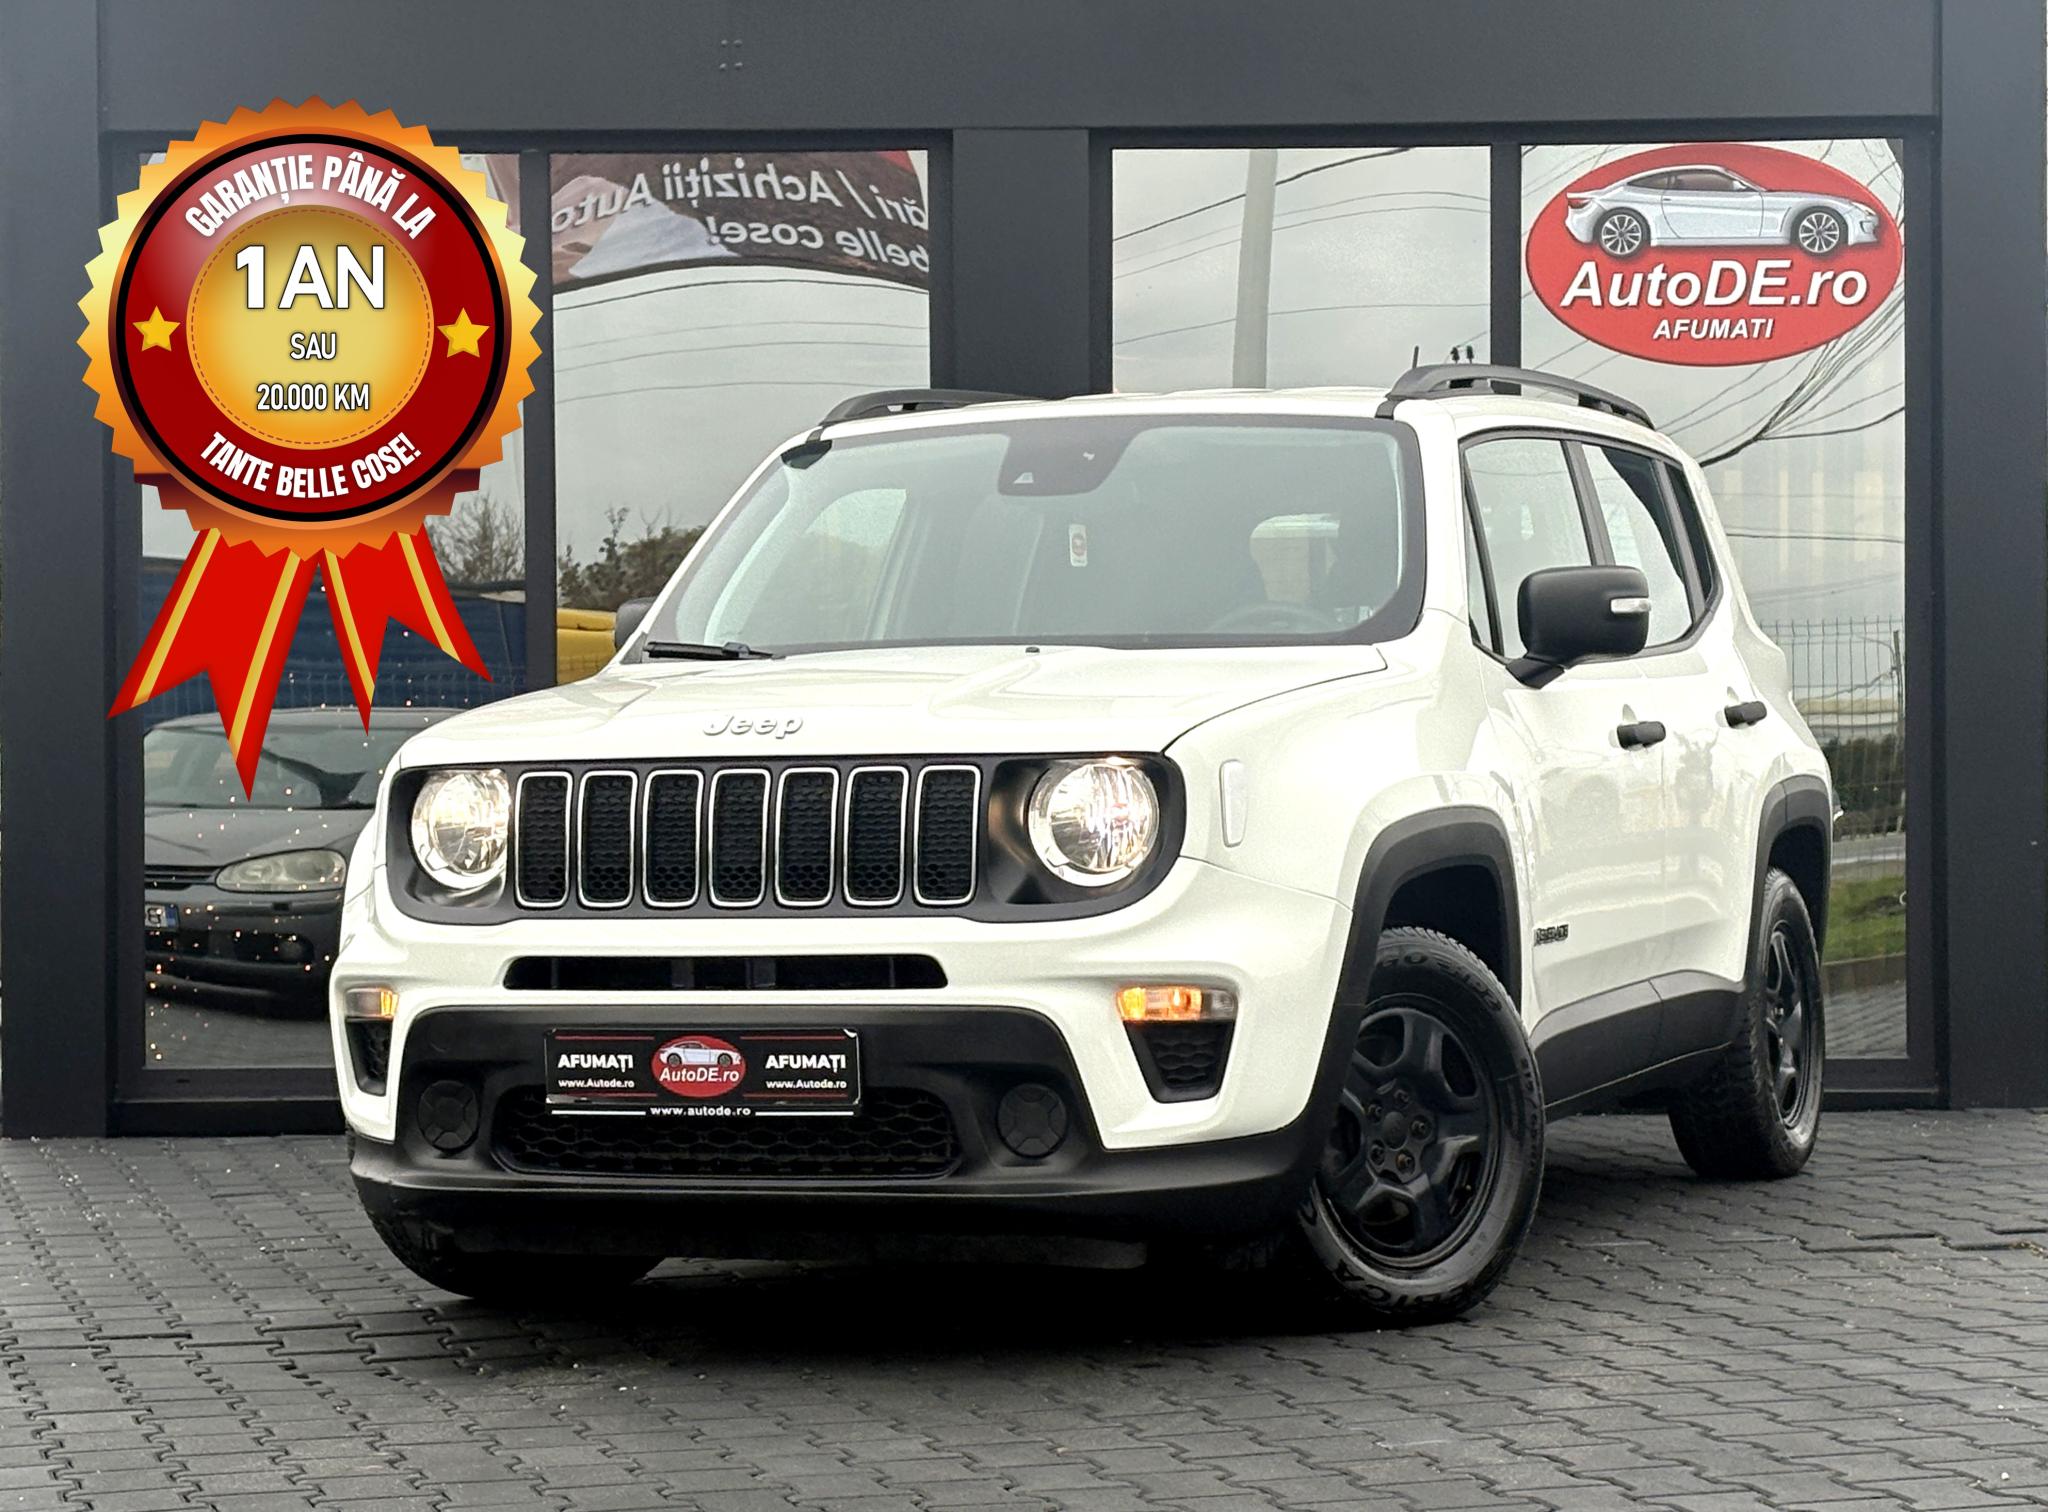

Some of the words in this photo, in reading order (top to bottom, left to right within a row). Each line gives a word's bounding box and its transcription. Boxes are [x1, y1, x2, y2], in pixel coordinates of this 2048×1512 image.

[1560, 259, 1869, 309] AutoDE.ro
[1652, 317, 1775, 340] AFUMATI
[703, 715, 804, 740] Jeep
[558, 1078, 635, 1089] www.Autode.ro
[658, 1066, 741, 1084] AutoDE.ro
[766, 1078, 848, 1090] www.Autode.ro
[650, 1105, 752, 1117] www.autode.ro
